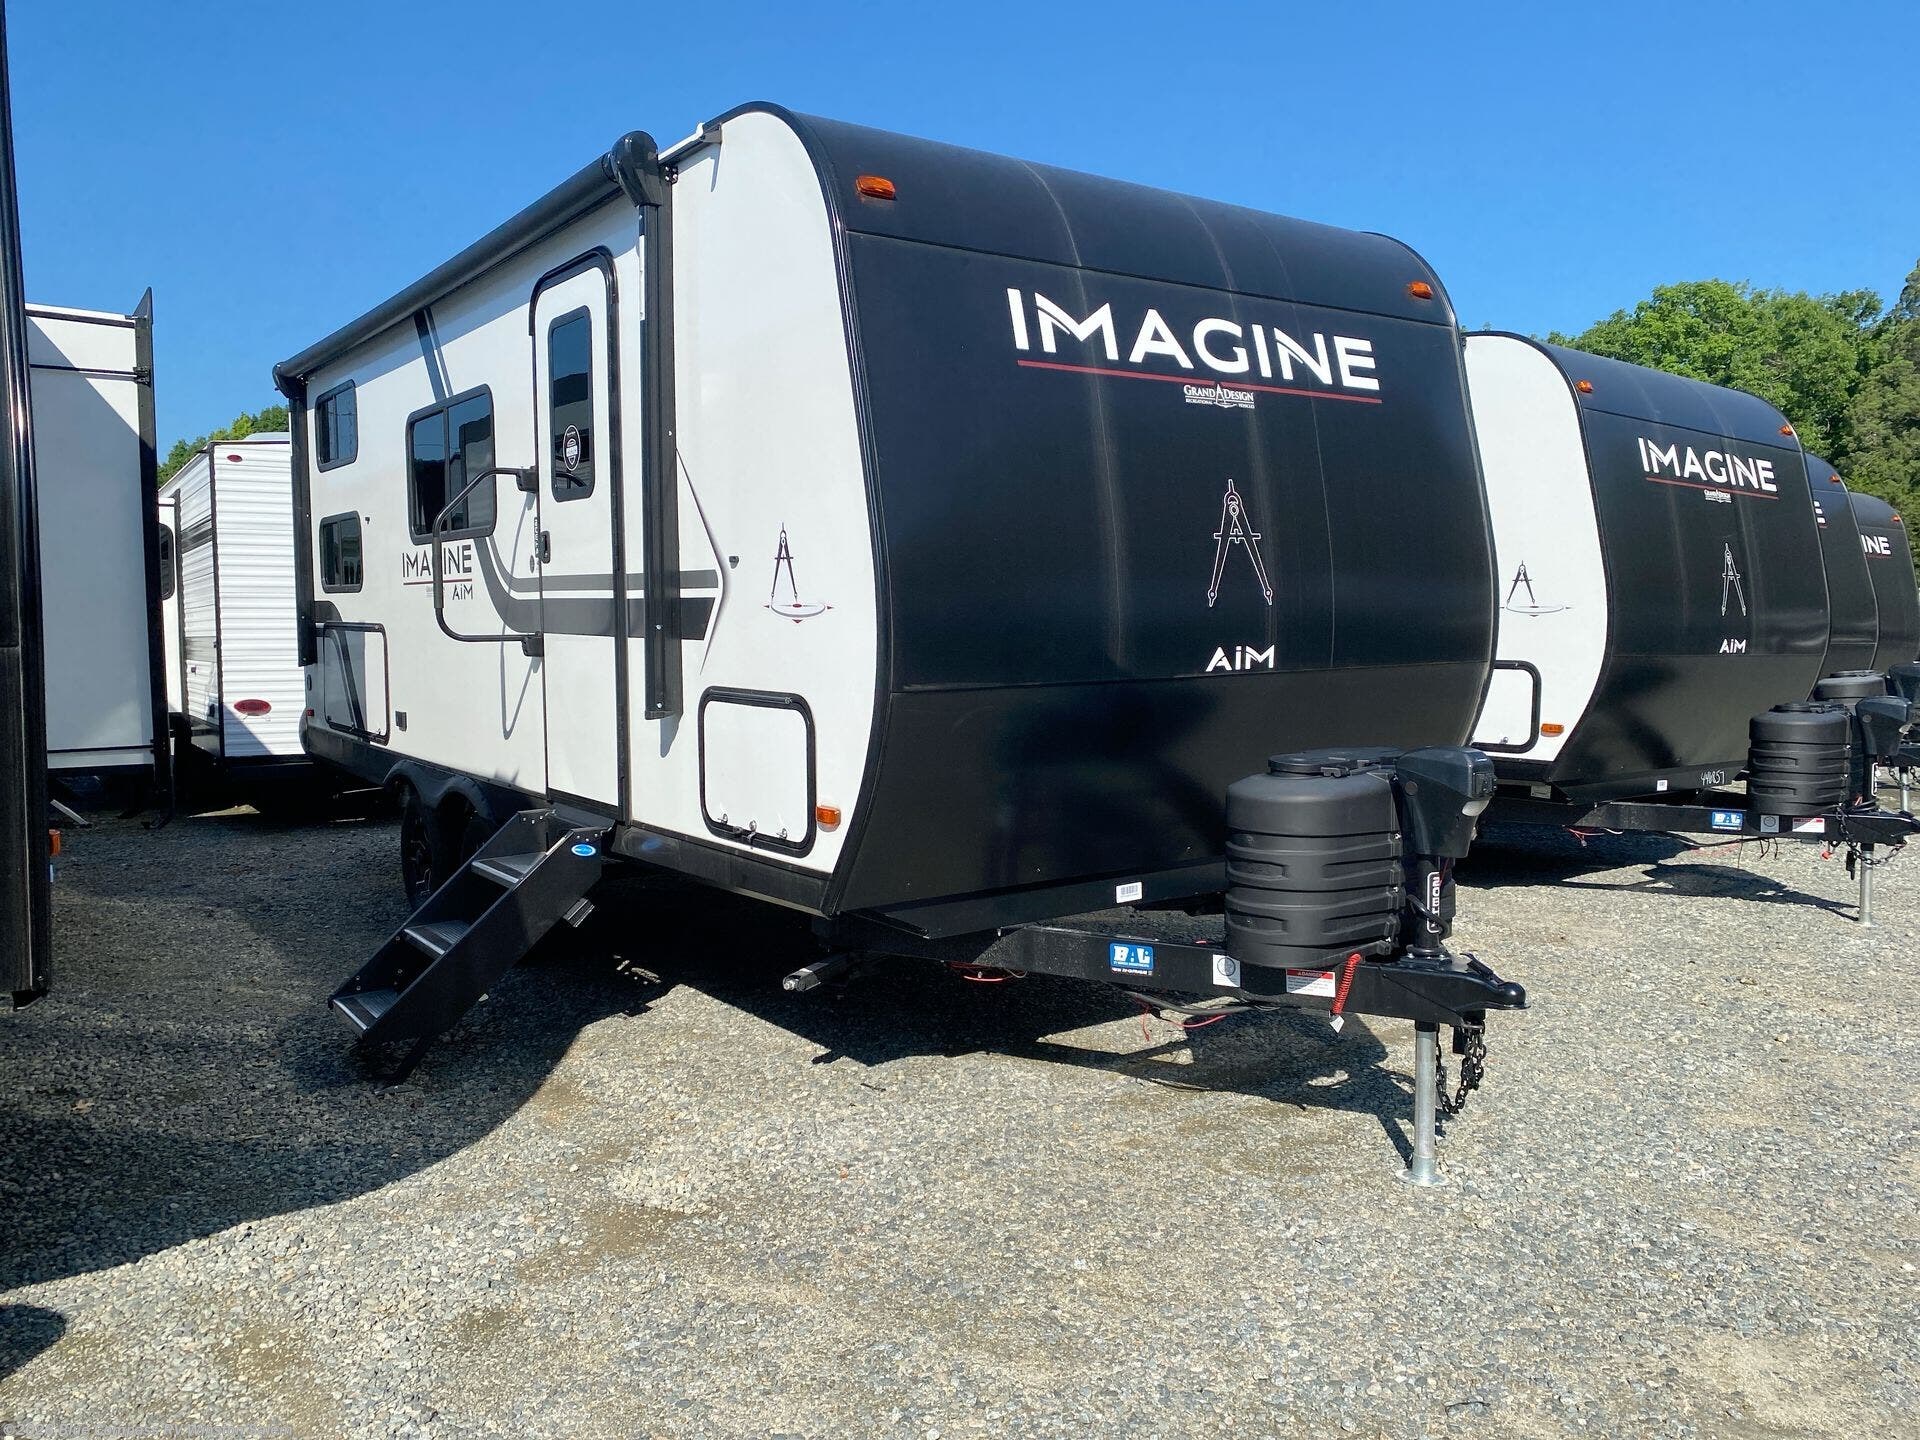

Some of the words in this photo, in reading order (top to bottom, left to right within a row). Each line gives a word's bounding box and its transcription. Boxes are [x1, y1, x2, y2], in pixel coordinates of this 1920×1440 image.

[1006, 287, 1380, 390] IMAGINE
[1183, 384, 1216, 398] GRAND
[1222, 388, 1254, 402] DESIGN
[1638, 437, 1777, 492] IMAGINE
[402, 544, 472, 578] IMAINE
[1861, 534, 1891, 555] INE
